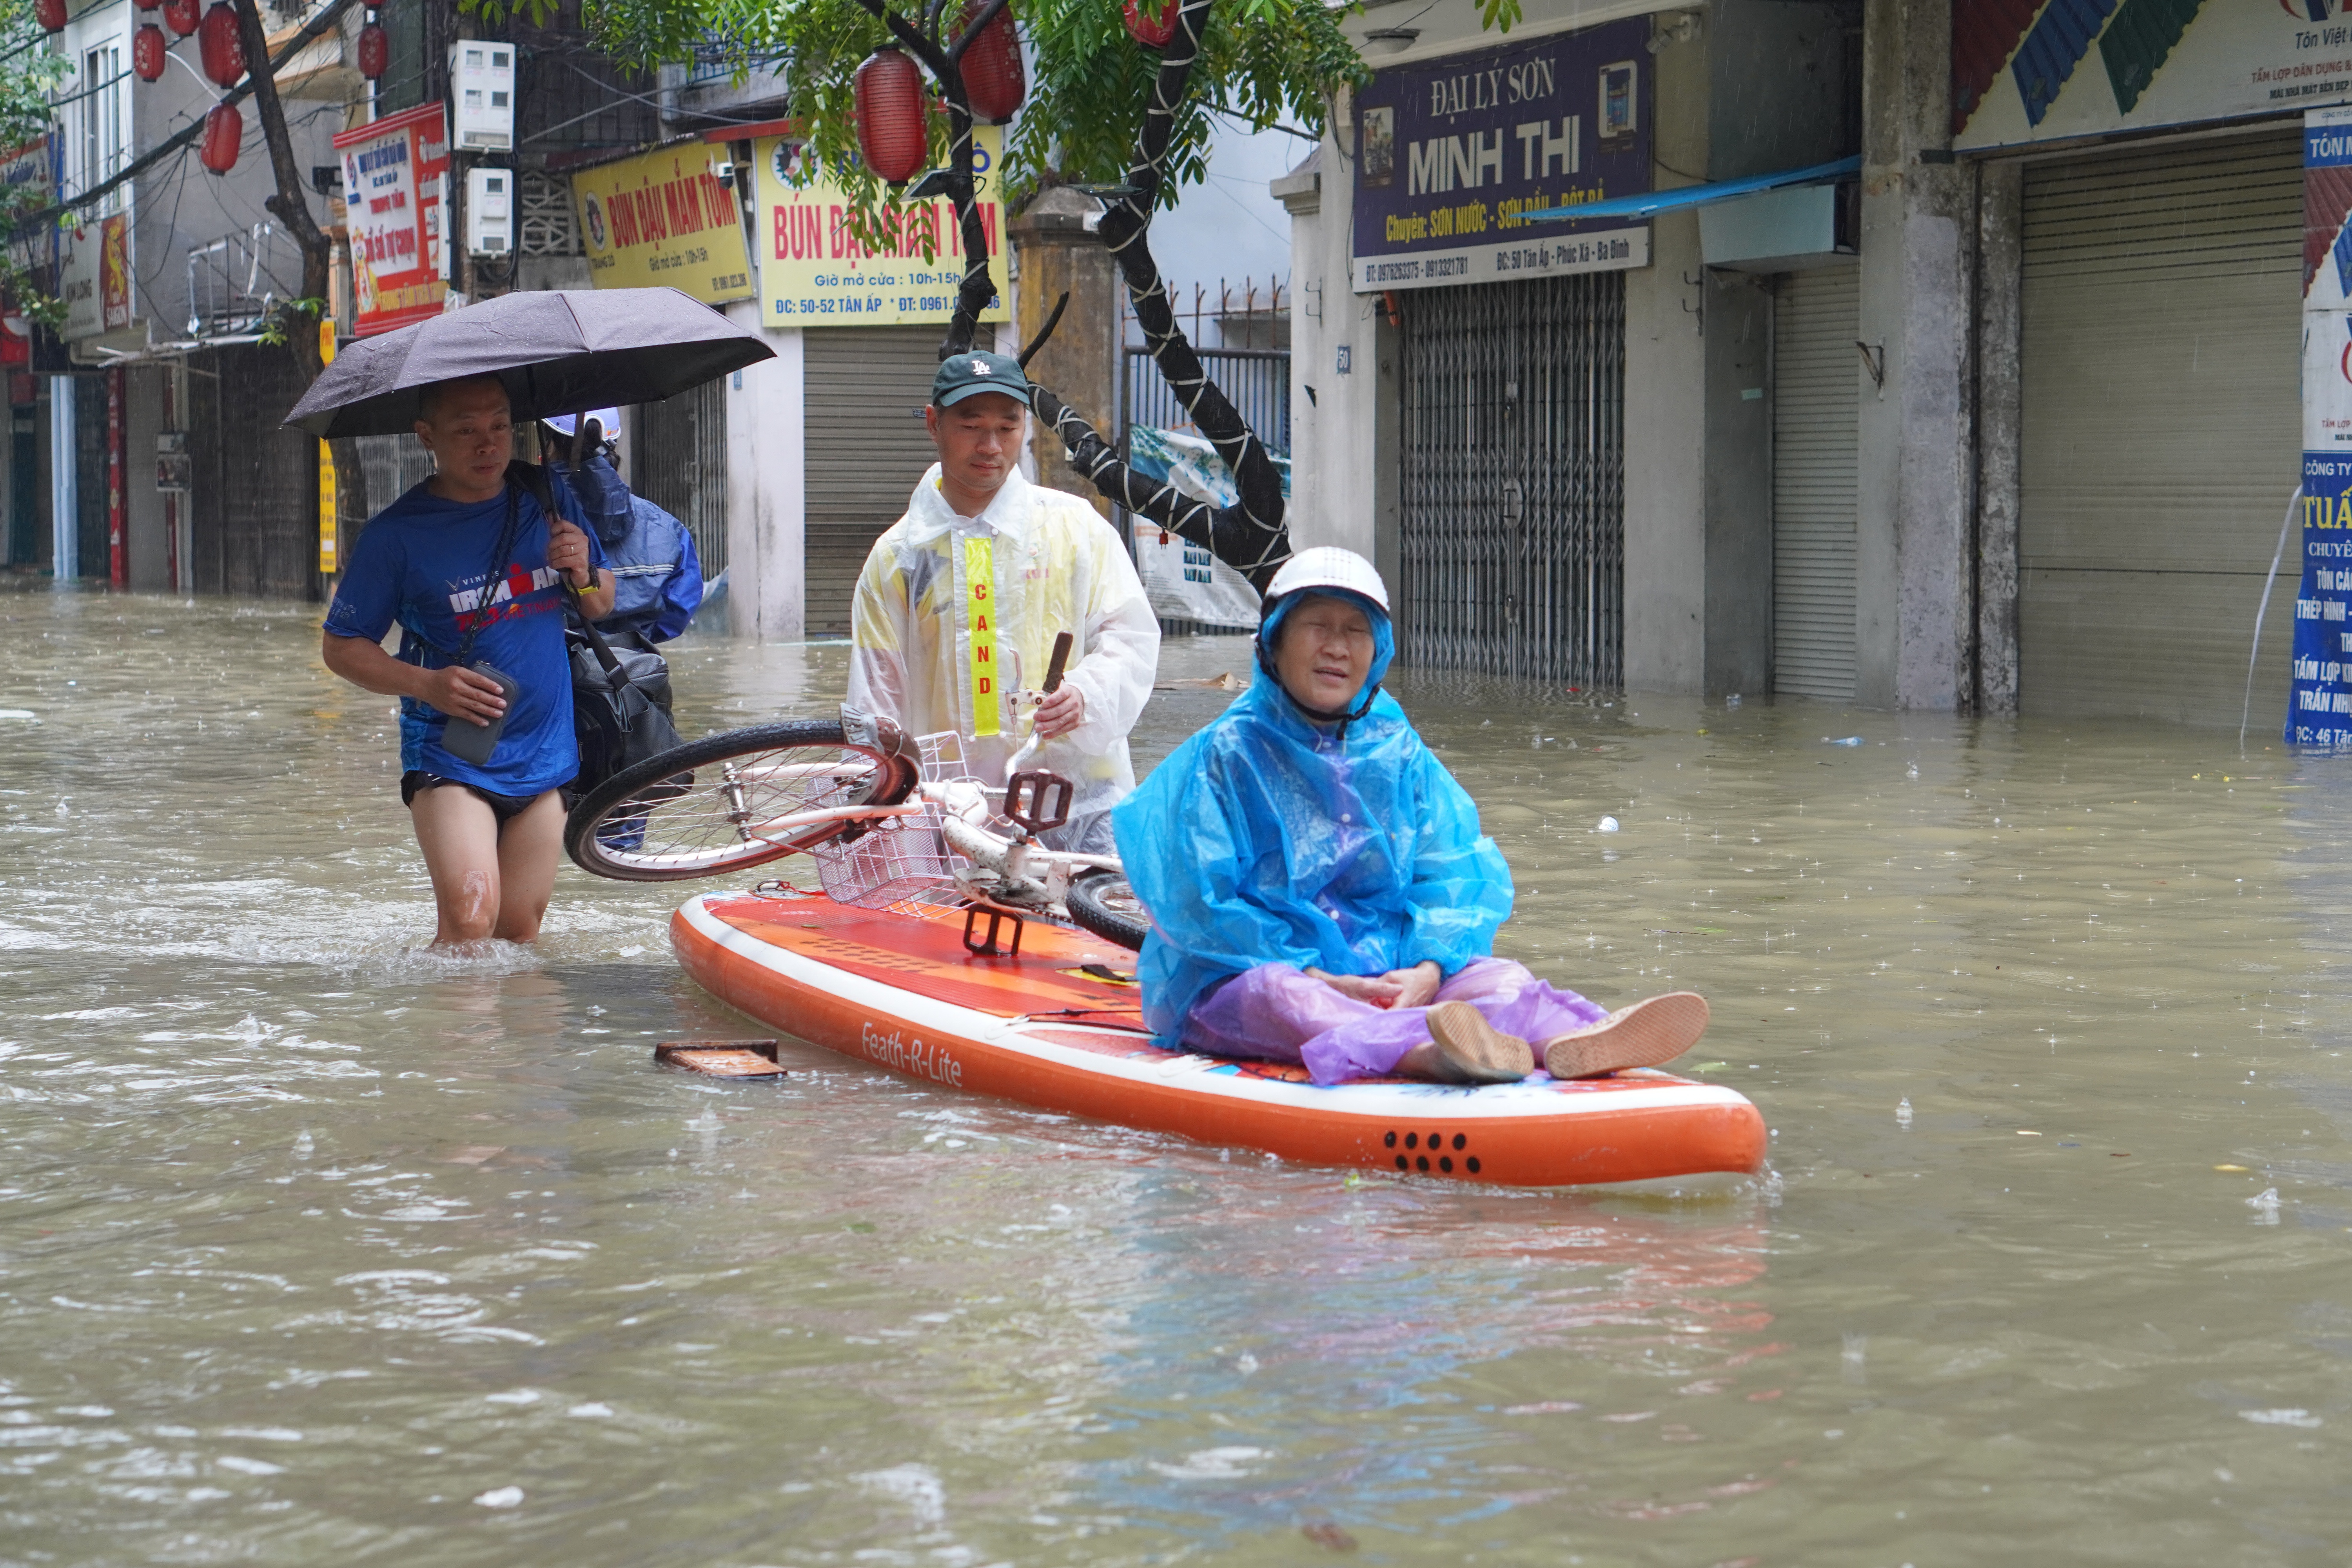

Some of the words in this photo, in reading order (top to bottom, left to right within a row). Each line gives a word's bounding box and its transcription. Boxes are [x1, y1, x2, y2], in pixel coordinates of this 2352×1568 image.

[2295, 31, 2318, 49] Tôn
[2323, 26, 2347, 48] Việt
[1431, 75, 1468, 125] ĐẠI
[1474, 58, 1504, 110] LÝ
[1508, 56, 1557, 105] SƠN
[1408, 128, 1503, 196] MINH
[1515, 114, 1580, 180] THI
[607, 182, 639, 248] BÚN
[635, 176, 666, 250] ĐẬU
[773, 192, 822, 260] BÚN
[947, 202, 997, 257] TM
[1386, 211, 1427, 244] Chuyên:
[1430, 206, 1453, 237] SƠN
[1455, 198, 1487, 234] NƯỚC
[1497, 196, 1522, 229] SƠN
[1512, 250, 1521, 269] 50
[1597, 241, 1608, 261] Ba
[815, 273, 838, 286] Giờ
[843, 272, 864, 286] mở
[869, 272, 895, 286] cửa
[909, 272, 961, 285] 10h-15h
[776, 300, 796, 314] ĐC:
[800, 299, 834, 313] 50-52
[838, 295, 862, 312] TÂN
[866, 292, 882, 312] ẤP
[898, 297, 916, 311] ĐT:
[972, 360, 991, 376] LA
[2305, 459, 2334, 476] CÔNG
[2336, 463, 2352, 476] TY
[449, 563, 560, 613] IRONMAN
[2336, 566, 2352, 591] CÁ
[2296, 596, 2322, 620] THÉP
[2323, 596, 2346, 622] HÌNH
[975, 584, 991, 694] CAND
[2294, 653, 2318, 681] TẤM
[2320, 660, 2341, 686] LỢP
[2299, 685, 2331, 712] TRẦN
[2316, 728, 2331, 744] 46
[862, 1022, 962, 1088] Feath-R-Lite
